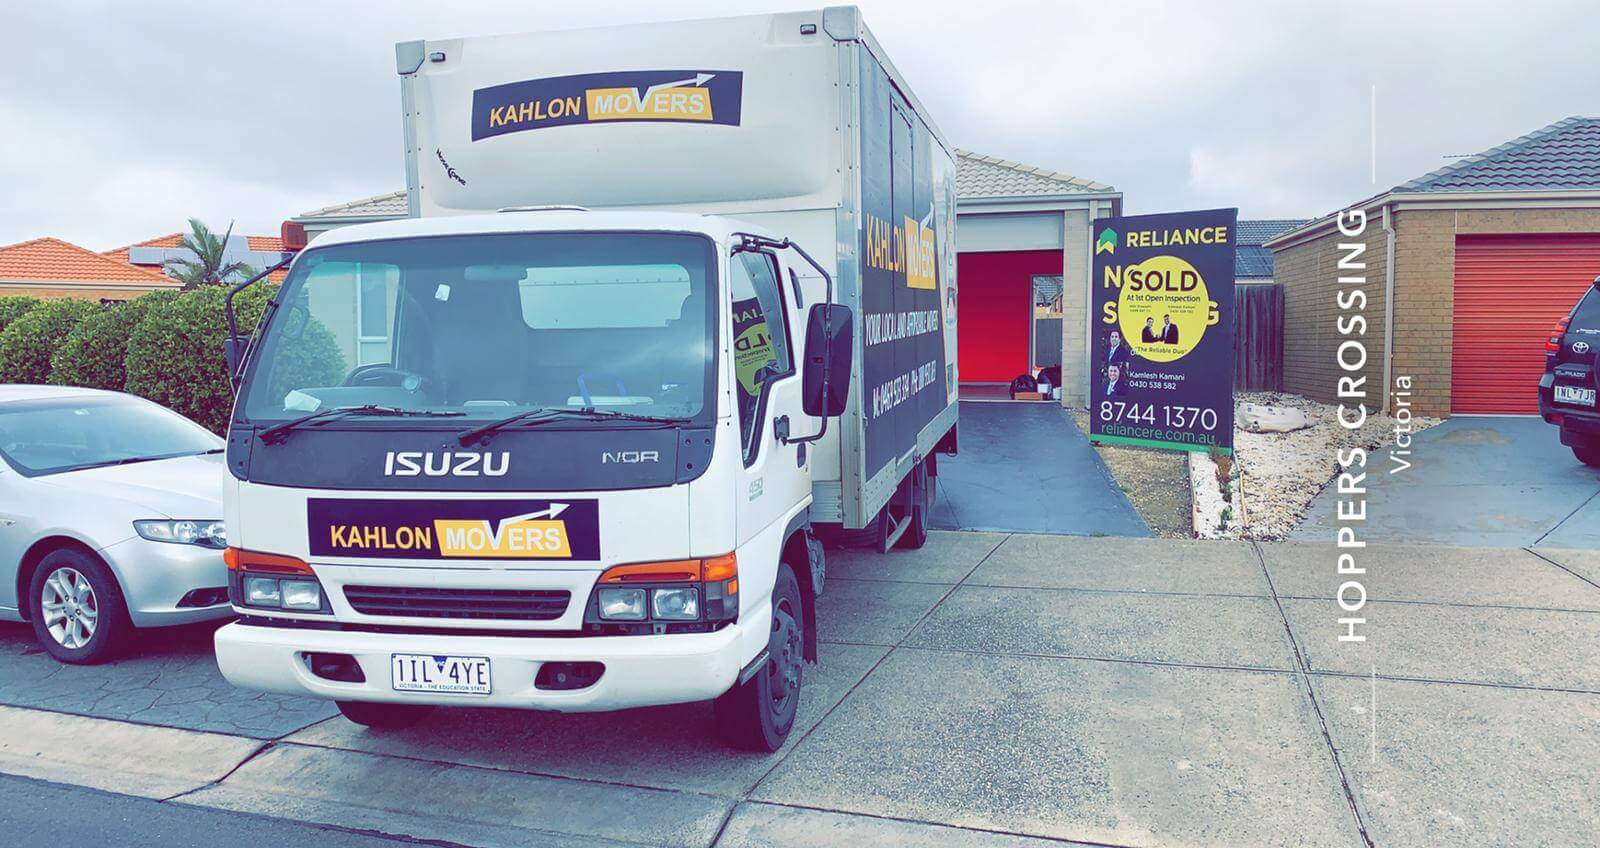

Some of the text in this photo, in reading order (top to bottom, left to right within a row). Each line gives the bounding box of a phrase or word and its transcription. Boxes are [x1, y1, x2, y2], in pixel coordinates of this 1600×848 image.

[489, 88, 705, 128] KAHLON MOVERS
[866, 212, 936, 279] KAHLON MOVERS
[1126, 226, 1228, 248] RELIANCE
[1129, 270, 1199, 292] SOLD
[1135, 294, 1144, 302] 1st
[1145, 295, 1164, 303] Open
[1165, 295, 1201, 303] Inspection
[865, 313, 881, 347] YOUR
[881, 312, 897, 343] LOCAL
[1129, 371, 1185, 381] Kamlesh Kamani
[1129, 380, 1177, 390] 0430 538 582
[1100, 401, 1218, 431] 8744 1370
[1101, 422, 1216, 445] reliancere.com.au
[384, 450, 660, 477] ISUZU NQR
[330, 520, 562, 551] KAHLON MOVERS
[398, 659, 487, 685] 1IL 4YE
